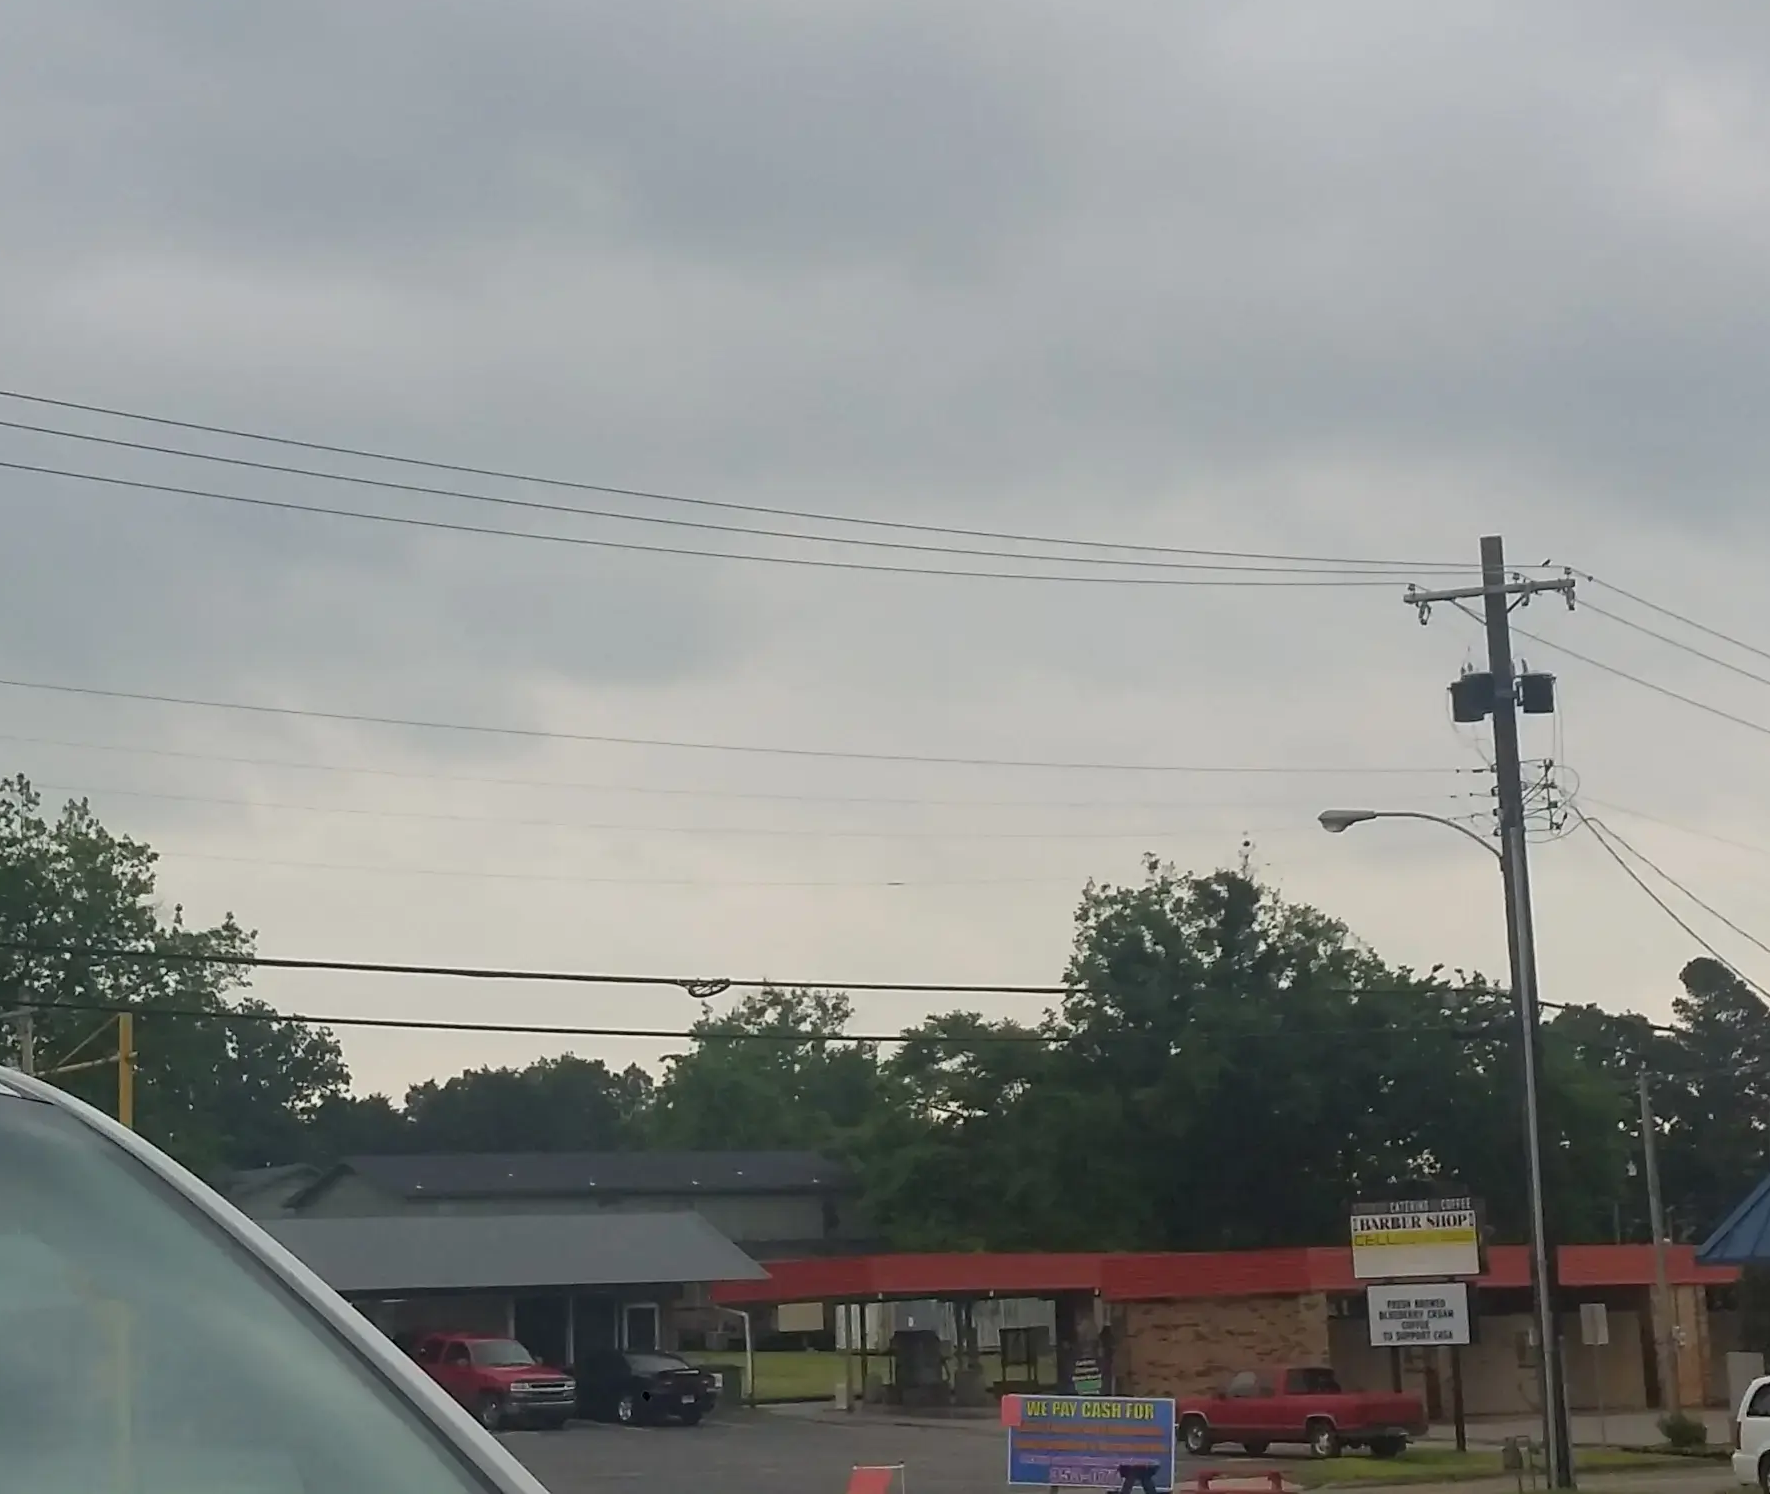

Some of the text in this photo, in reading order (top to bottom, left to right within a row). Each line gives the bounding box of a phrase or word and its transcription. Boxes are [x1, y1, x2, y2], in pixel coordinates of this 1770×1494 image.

[1359, 1213, 1468, 1232] BARBER SHOP
[1026, 1401, 1155, 1420] WE PAY CASH FOR
